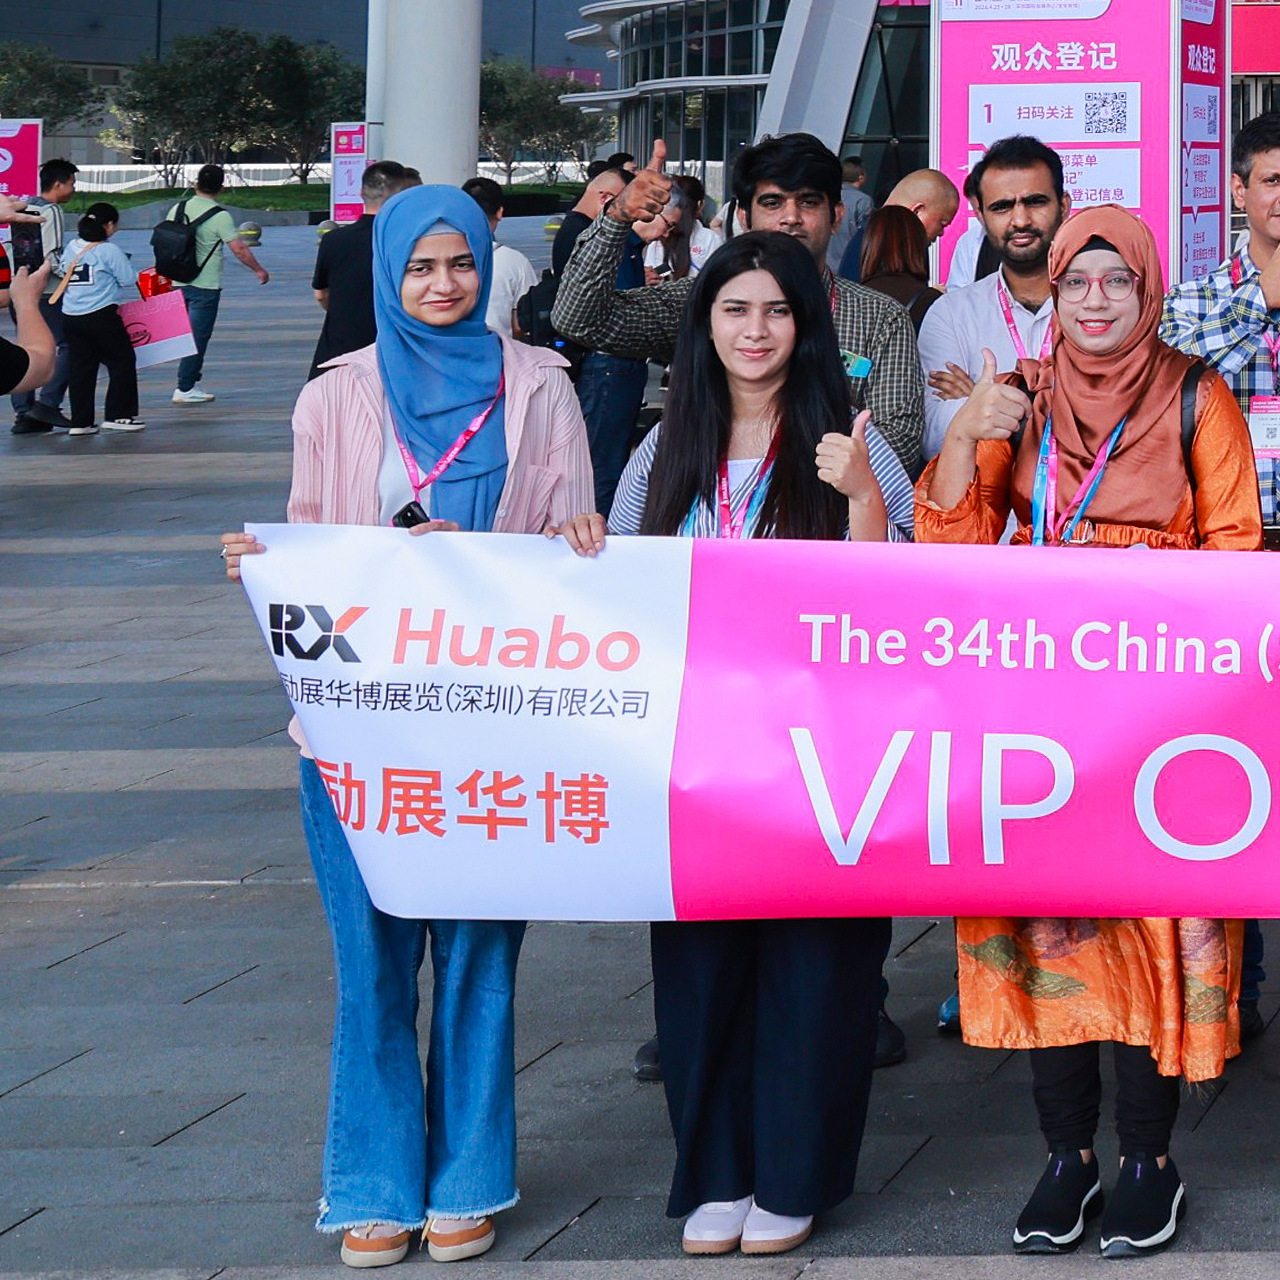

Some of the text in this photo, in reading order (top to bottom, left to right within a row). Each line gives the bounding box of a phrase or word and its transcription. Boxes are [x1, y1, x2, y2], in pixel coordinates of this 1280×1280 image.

[991, 41, 1118, 71] 观众登记
[1188, 44, 1216, 74] 观众登记
[984, 104, 993, 124] 1
[1016, 105, 1075, 120] 扫码关注
[1064, 188, 1125, 202] 登记信息
[269, 603, 640, 672] RX Huabo
[800, 613, 907, 666] The
[922, 616, 1056, 670] 34th
[1071, 620, 1242, 675] China
[788, 726, 1076, 867] VIP
